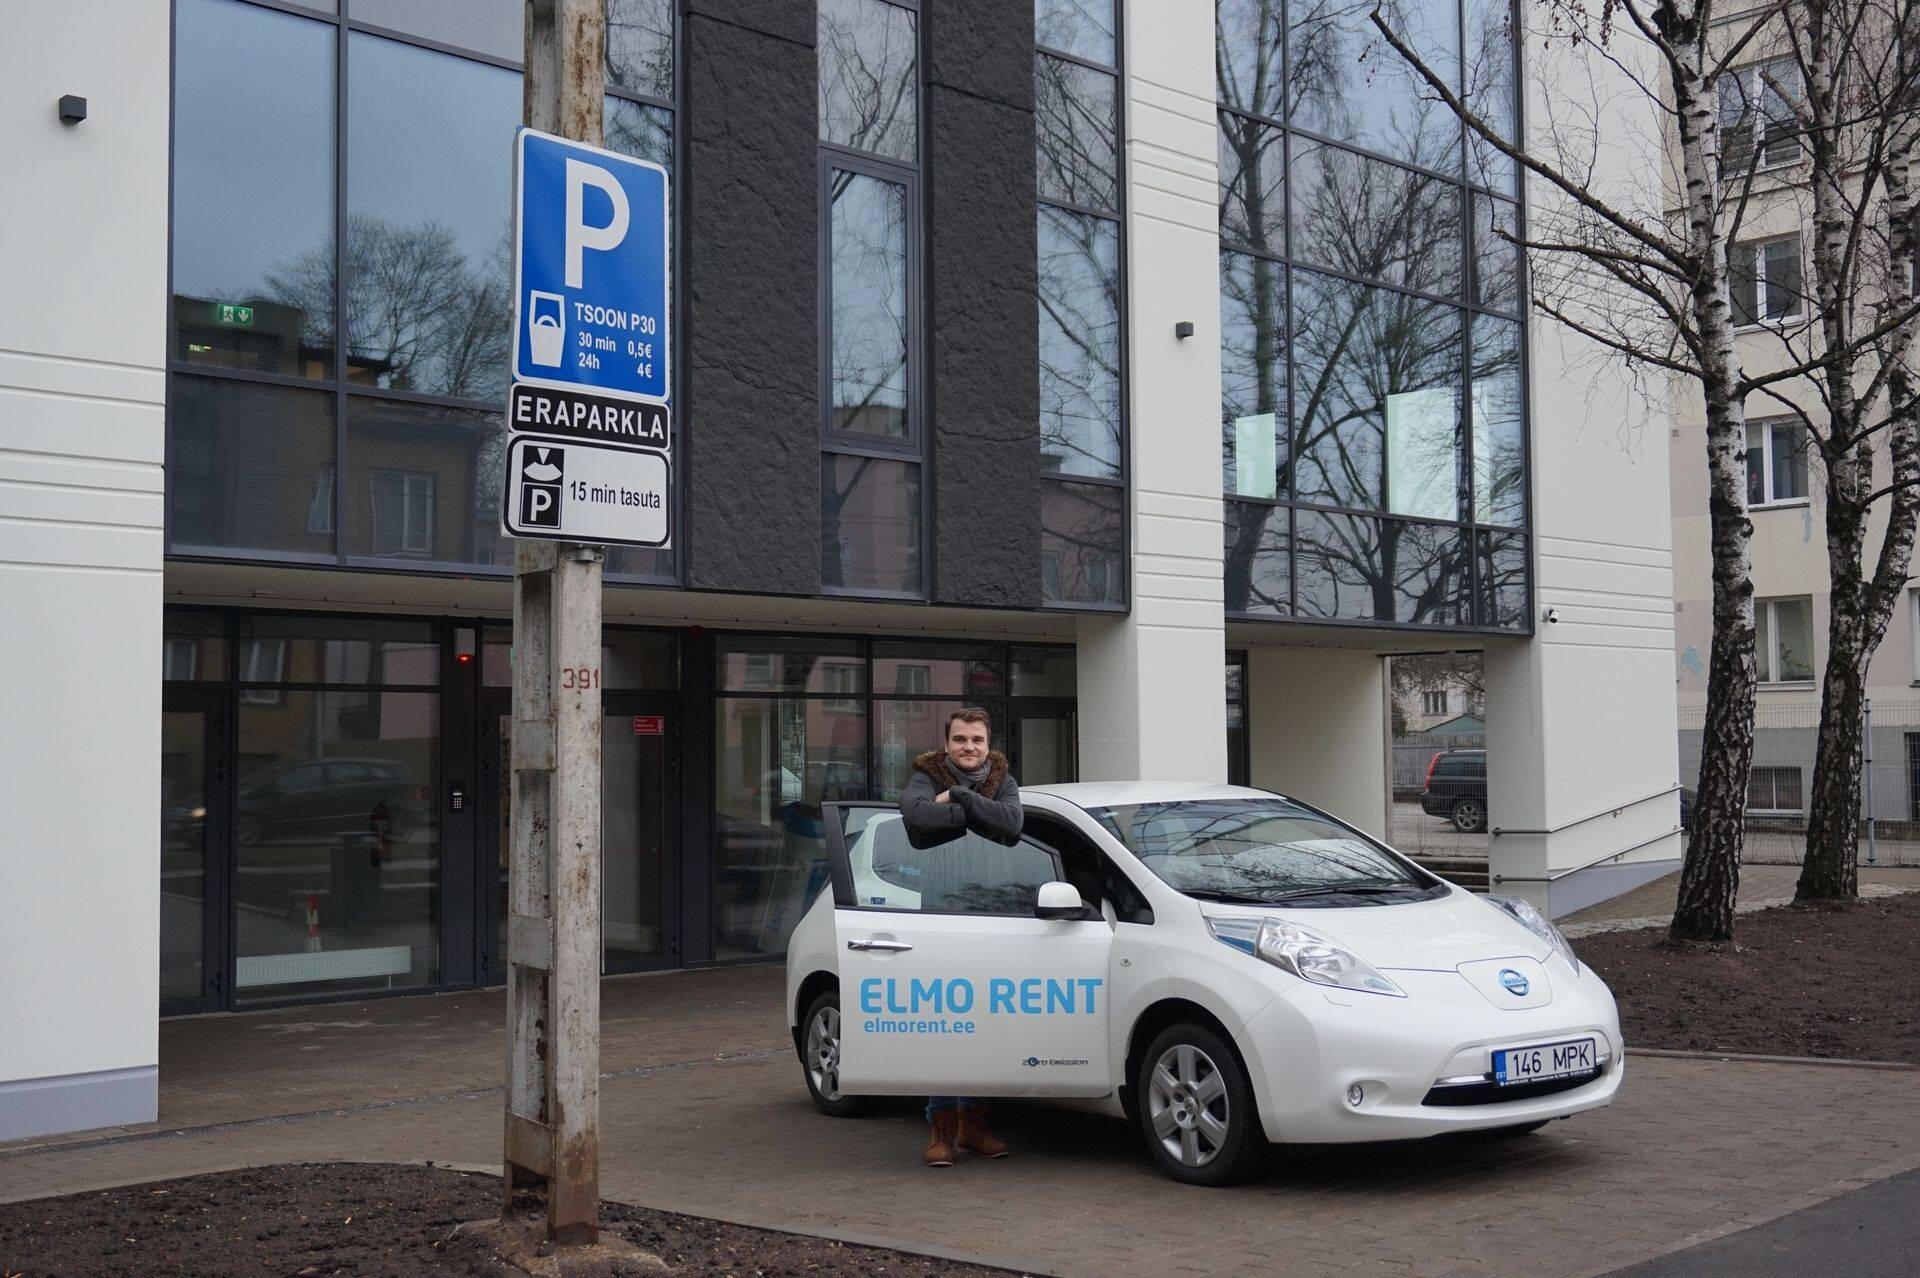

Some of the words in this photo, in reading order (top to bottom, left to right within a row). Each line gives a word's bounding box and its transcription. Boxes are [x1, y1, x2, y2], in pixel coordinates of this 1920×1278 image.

[565, 157, 630, 289] P
[575, 302, 627, 330] TSOON
[631, 313, 656, 335] P30
[578, 331, 592, 348] 30
[595, 336, 617, 352] min
[628, 340, 652, 359] 0,5€
[578, 352, 600, 370] 24h
[637, 362, 652, 379] 4€
[517, 395, 664, 440] ERAPARKLA
[530, 488, 552, 522] P
[570, 480, 587, 501] 15
[591, 484, 616, 505] min
[620, 486, 661, 509] tasuta
[563, 668, 599, 689] 391
[860, 978, 974, 1014] ELMO
[990, 978, 1103, 1014] RENT
[864, 1017, 975, 1034] elmorent.ee
[1513, 1051, 1541, 1076] 146
[1553, 1043, 1590, 1071] MPK
[1496, 1071, 1507, 1080] EST
